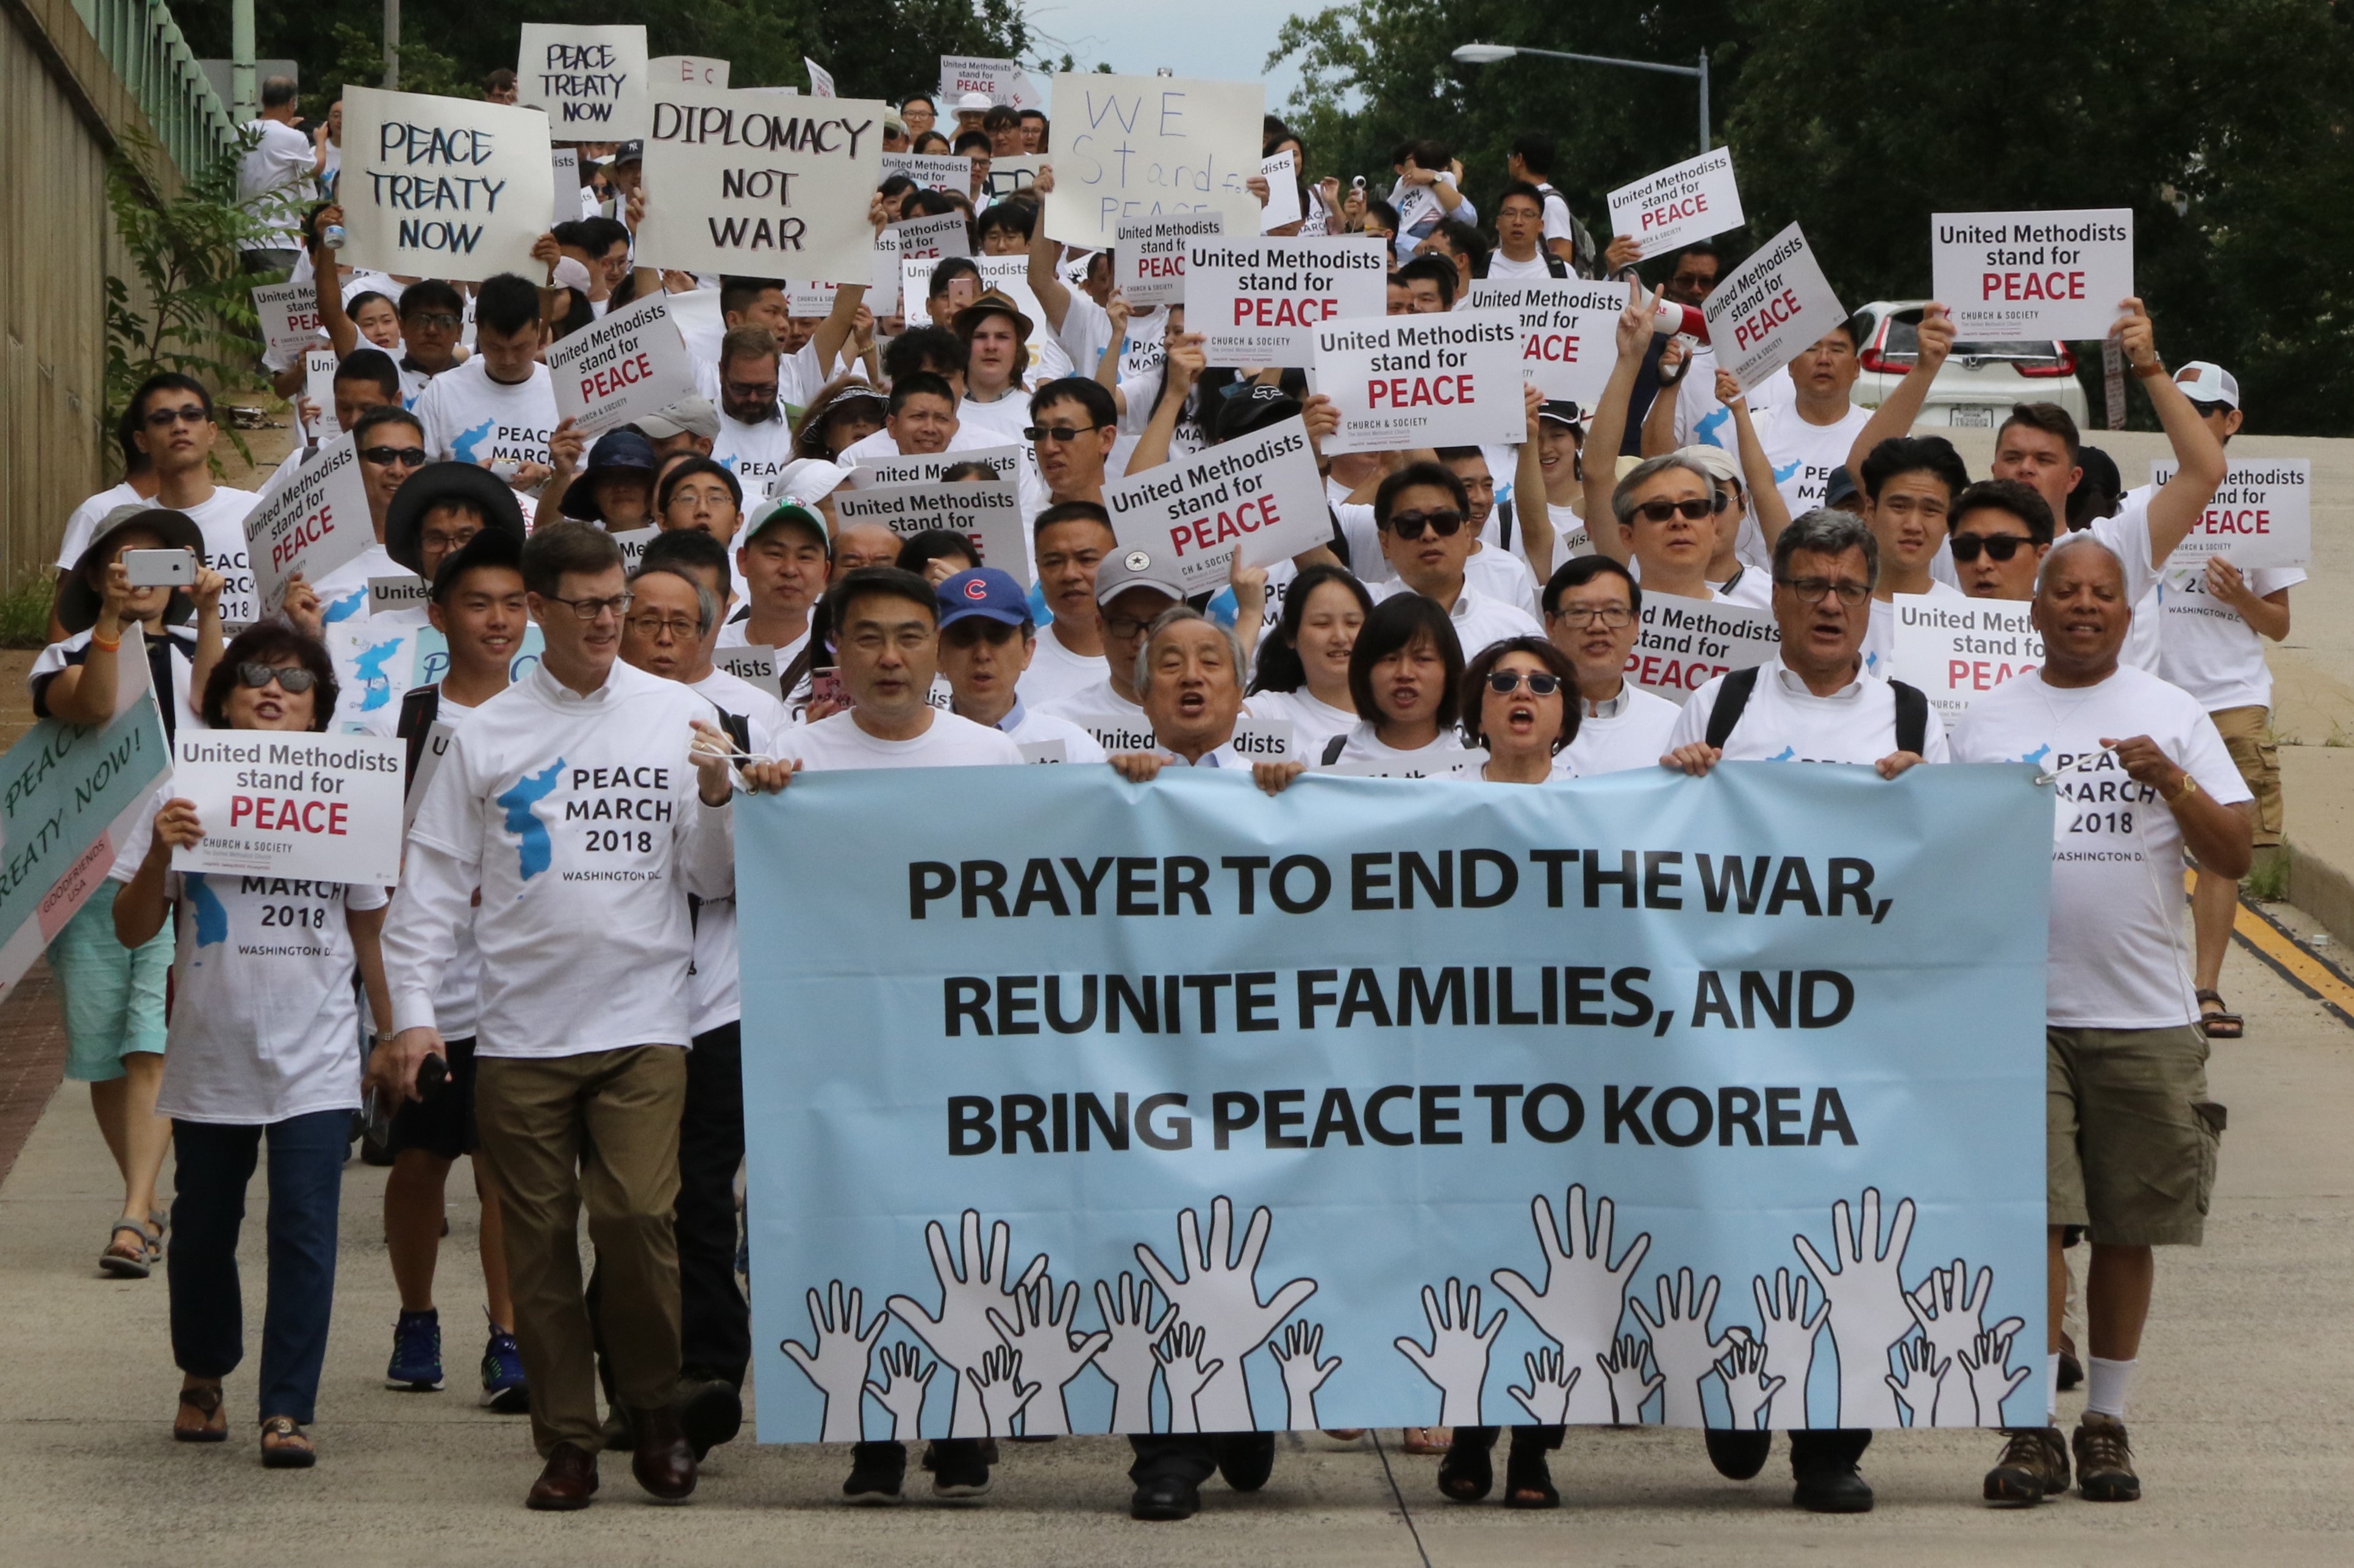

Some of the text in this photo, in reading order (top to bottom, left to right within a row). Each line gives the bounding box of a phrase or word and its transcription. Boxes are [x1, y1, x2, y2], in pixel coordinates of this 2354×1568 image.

[547, 45, 616, 70] PEACE
[943, 60, 1011, 71] United Methodists
[538, 73, 626, 99] TREATY
[957, 81, 995, 92] PEACE
[562, 102, 612, 123] NOW
[652, 102, 872, 159] DIPLOMACY
[379, 121, 494, 166] PEACE
[882, 158, 968, 172] United Methodists
[931, 171, 945, 181] for
[365, 168, 506, 213] TREATY
[723, 168, 798, 207] NOT
[1612, 157, 1727, 209] United Methodists
[1642, 181, 1700, 210] stand for
[1641, 193, 1708, 231] PEACE
[398, 215, 483, 255] NOW
[708, 217, 807, 252] WAR
[898, 220, 962, 238] ethodists
[1118, 221, 1220, 240] United Methodists
[1940, 224, 2127, 244] United Methodists
[916, 237, 934, 247] for
[1141, 240, 1174, 254] stand
[1139, 256, 1185, 278] PEAC
[1192, 249, 1381, 270] United Methodists
[1986, 246, 2080, 265] stand for
[1239, 273, 1334, 292] stand for
[1706, 237, 1803, 324] United Methodists
[1983, 271, 2085, 301] PEACE
[257, 288, 295, 304] United
[1472, 290, 1622, 311] United Methodists
[1731, 273, 1784, 322] stand for
[287, 313, 323, 332] PEA
[1234, 298, 1338, 328] PEACE
[1519, 311, 1578, 329] and for
[1734, 288, 1801, 351] PEACE
[550, 304, 666, 371] United Methodists
[1212, 337, 1244, 345] CHURCH
[1257, 337, 1290, 346] SOCIETY
[1320, 323, 1514, 352] United Methodists
[1522, 334, 1579, 363] ACE
[579, 338, 639, 374] stand for
[1371, 349, 1467, 372] stand for
[581, 353, 653, 404] PEACE
[1368, 374, 1475, 409] PEACE
[498, 427, 550, 443] PEAC
[1347, 420, 1381, 429] CHURCH
[1393, 418, 1427, 427] SOCIETY
[492, 447, 554, 465] MARC
[875, 465, 919, 482] nited
[1112, 434, 1304, 514] United Methodists
[2223, 470, 2305, 485] ethodists
[247, 448, 352, 542] United Methodists
[842, 493, 1014, 517] United Methodists
[1168, 472, 1263, 520] stand for
[2208, 489, 2266, 504] and for
[271, 489, 325, 540] stand for
[889, 512, 975, 531] stand for
[1170, 493, 1280, 557] PEACE
[272, 505, 335, 574] PEACE
[1901, 607, 1975, 630] United
[2169, 606, 2226, 619] WASHINGTON
[1663, 608, 1781, 642] Methodists
[1698, 637, 1730, 658] for
[1953, 636, 2045, 657] stand fo
[183, 743, 398, 773] United Methodists
[74, 728, 141, 814] NOW!
[237, 769, 345, 794] stand for
[573, 766, 668, 790] PEACE
[231, 796, 349, 836] PEACE
[566, 798, 671, 823] MARCH
[2069, 813, 2133, 833] 2018
[203, 838, 240, 850] CHURCH
[254, 842, 292, 853] SOCIETY
[585, 830, 652, 853] 2018
[2052, 852, 2131, 862] ASHINGTON
[43, 840, 105, 914] GOODFRIENDS
[563, 871, 645, 881] WASHINGTON
[909, 848, 1893, 924] PRAYER TO END THE WAR,
[67, 879, 86, 903] USA
[241, 876, 343, 901] MARCH
[261, 905, 325, 929] 2018
[238, 945, 321, 956] WASHINGTON
[944, 966, 1855, 1037] REUNITE FAMILIES, AND
[948, 1083, 1858, 1156] BRING PEACE TO KOREA
